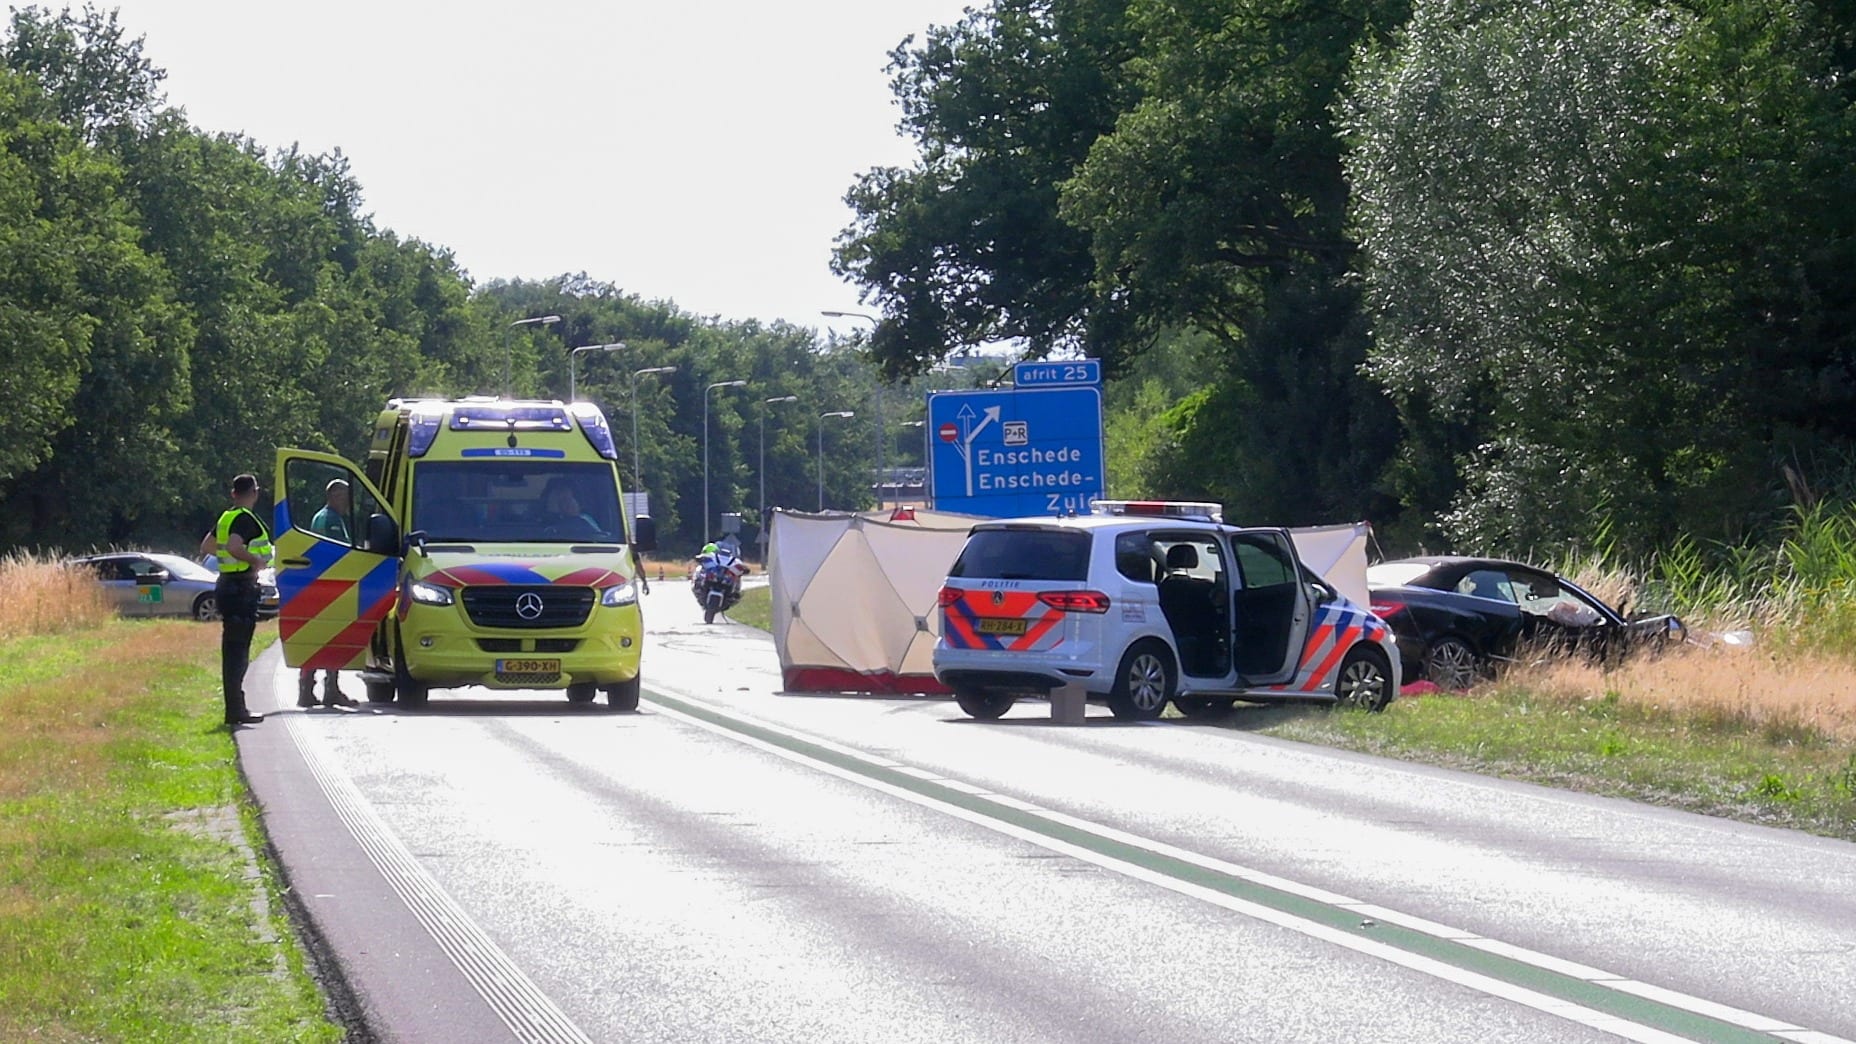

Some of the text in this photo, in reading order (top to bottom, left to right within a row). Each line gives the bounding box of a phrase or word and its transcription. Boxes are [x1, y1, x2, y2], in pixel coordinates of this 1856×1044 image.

[1023, 366, 1088, 380] afrit 25
[1004, 427, 1026, 439] P+R
[977, 447, 1081, 466] Enschede
[979, 470, 1094, 489] Enschede-
[981, 580, 1020, 588] POLITIE
[504, 660, 557, 671] G-390-XH
